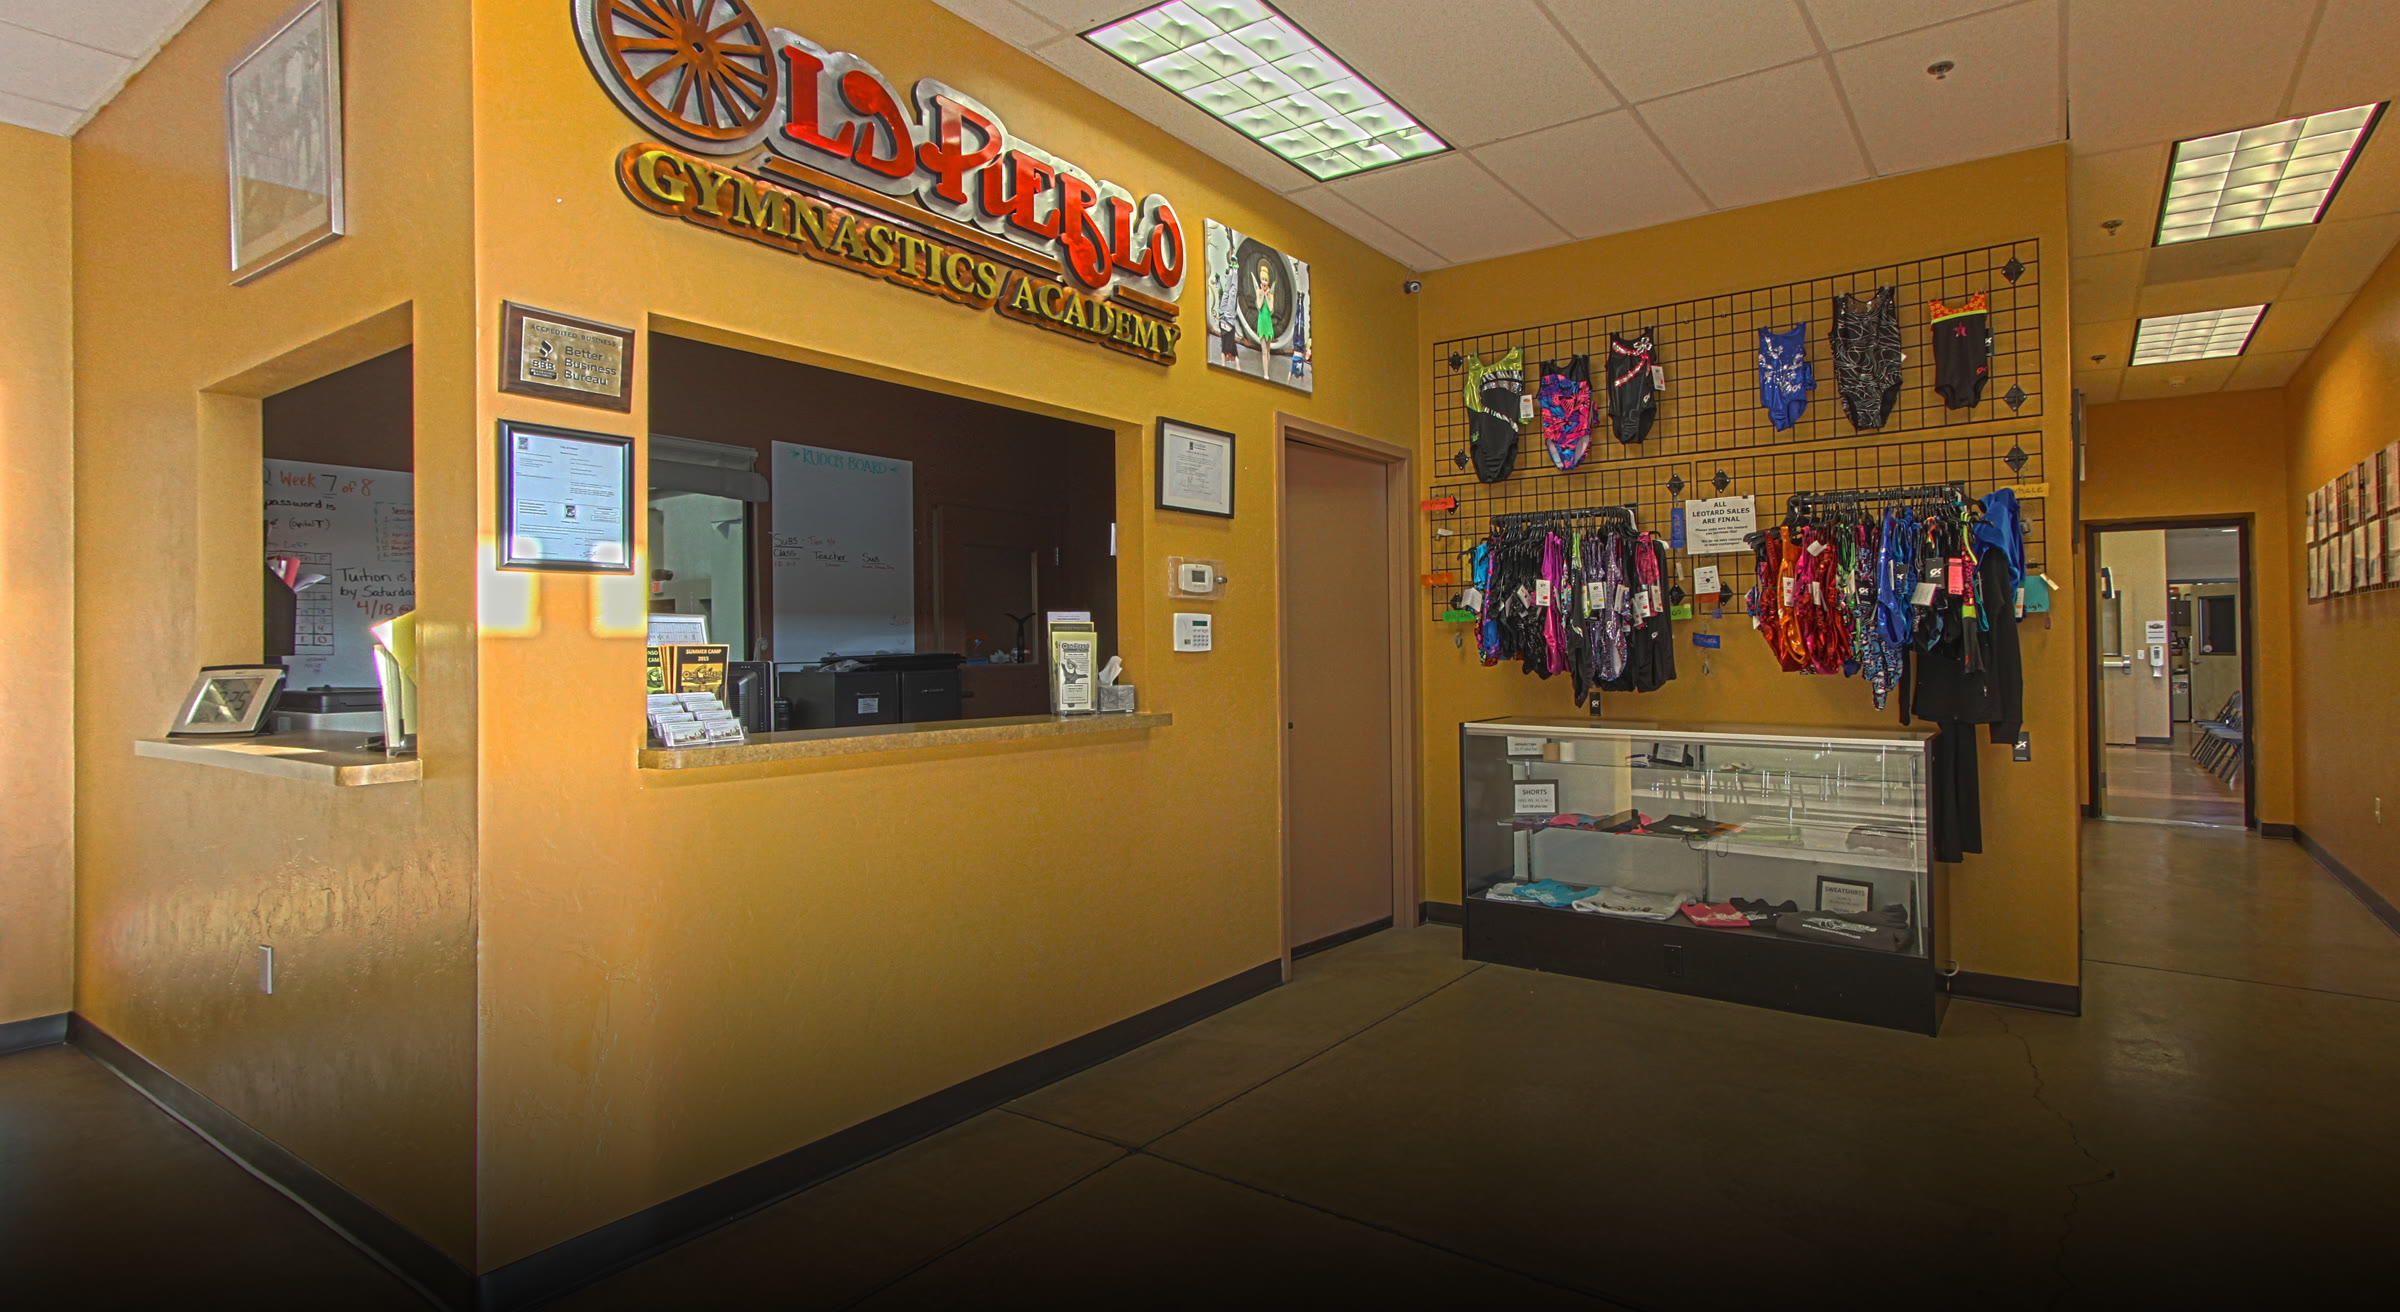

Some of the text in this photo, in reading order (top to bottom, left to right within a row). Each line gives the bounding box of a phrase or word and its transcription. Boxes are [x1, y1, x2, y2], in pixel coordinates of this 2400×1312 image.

[636, 149, 1182, 363] GYMNASTICS ACADEMY
[530, 324, 616, 346] ACCREDITED BUSINESS
[565, 346, 603, 361] Better
[532, 360, 555, 371] BBB
[564, 358, 617, 376] Business
[564, 370, 609, 386] Bureau
[802, 448, 888, 474] KUDOS BOARD
[280, 470, 317, 488] Week
[341, 482, 357, 493] of
[360, 478, 375, 496] 8
[264, 499, 337, 511] password is
[1692, 509, 1725, 517] LEOTARD
[335, 567, 392, 583] Tuition
[396, 572, 407, 582] is
[340, 586, 415, 598] by Saturda
[356, 600, 394, 619] 4/18
[1825, 887, 1865, 896] SWEATSHIRTS
